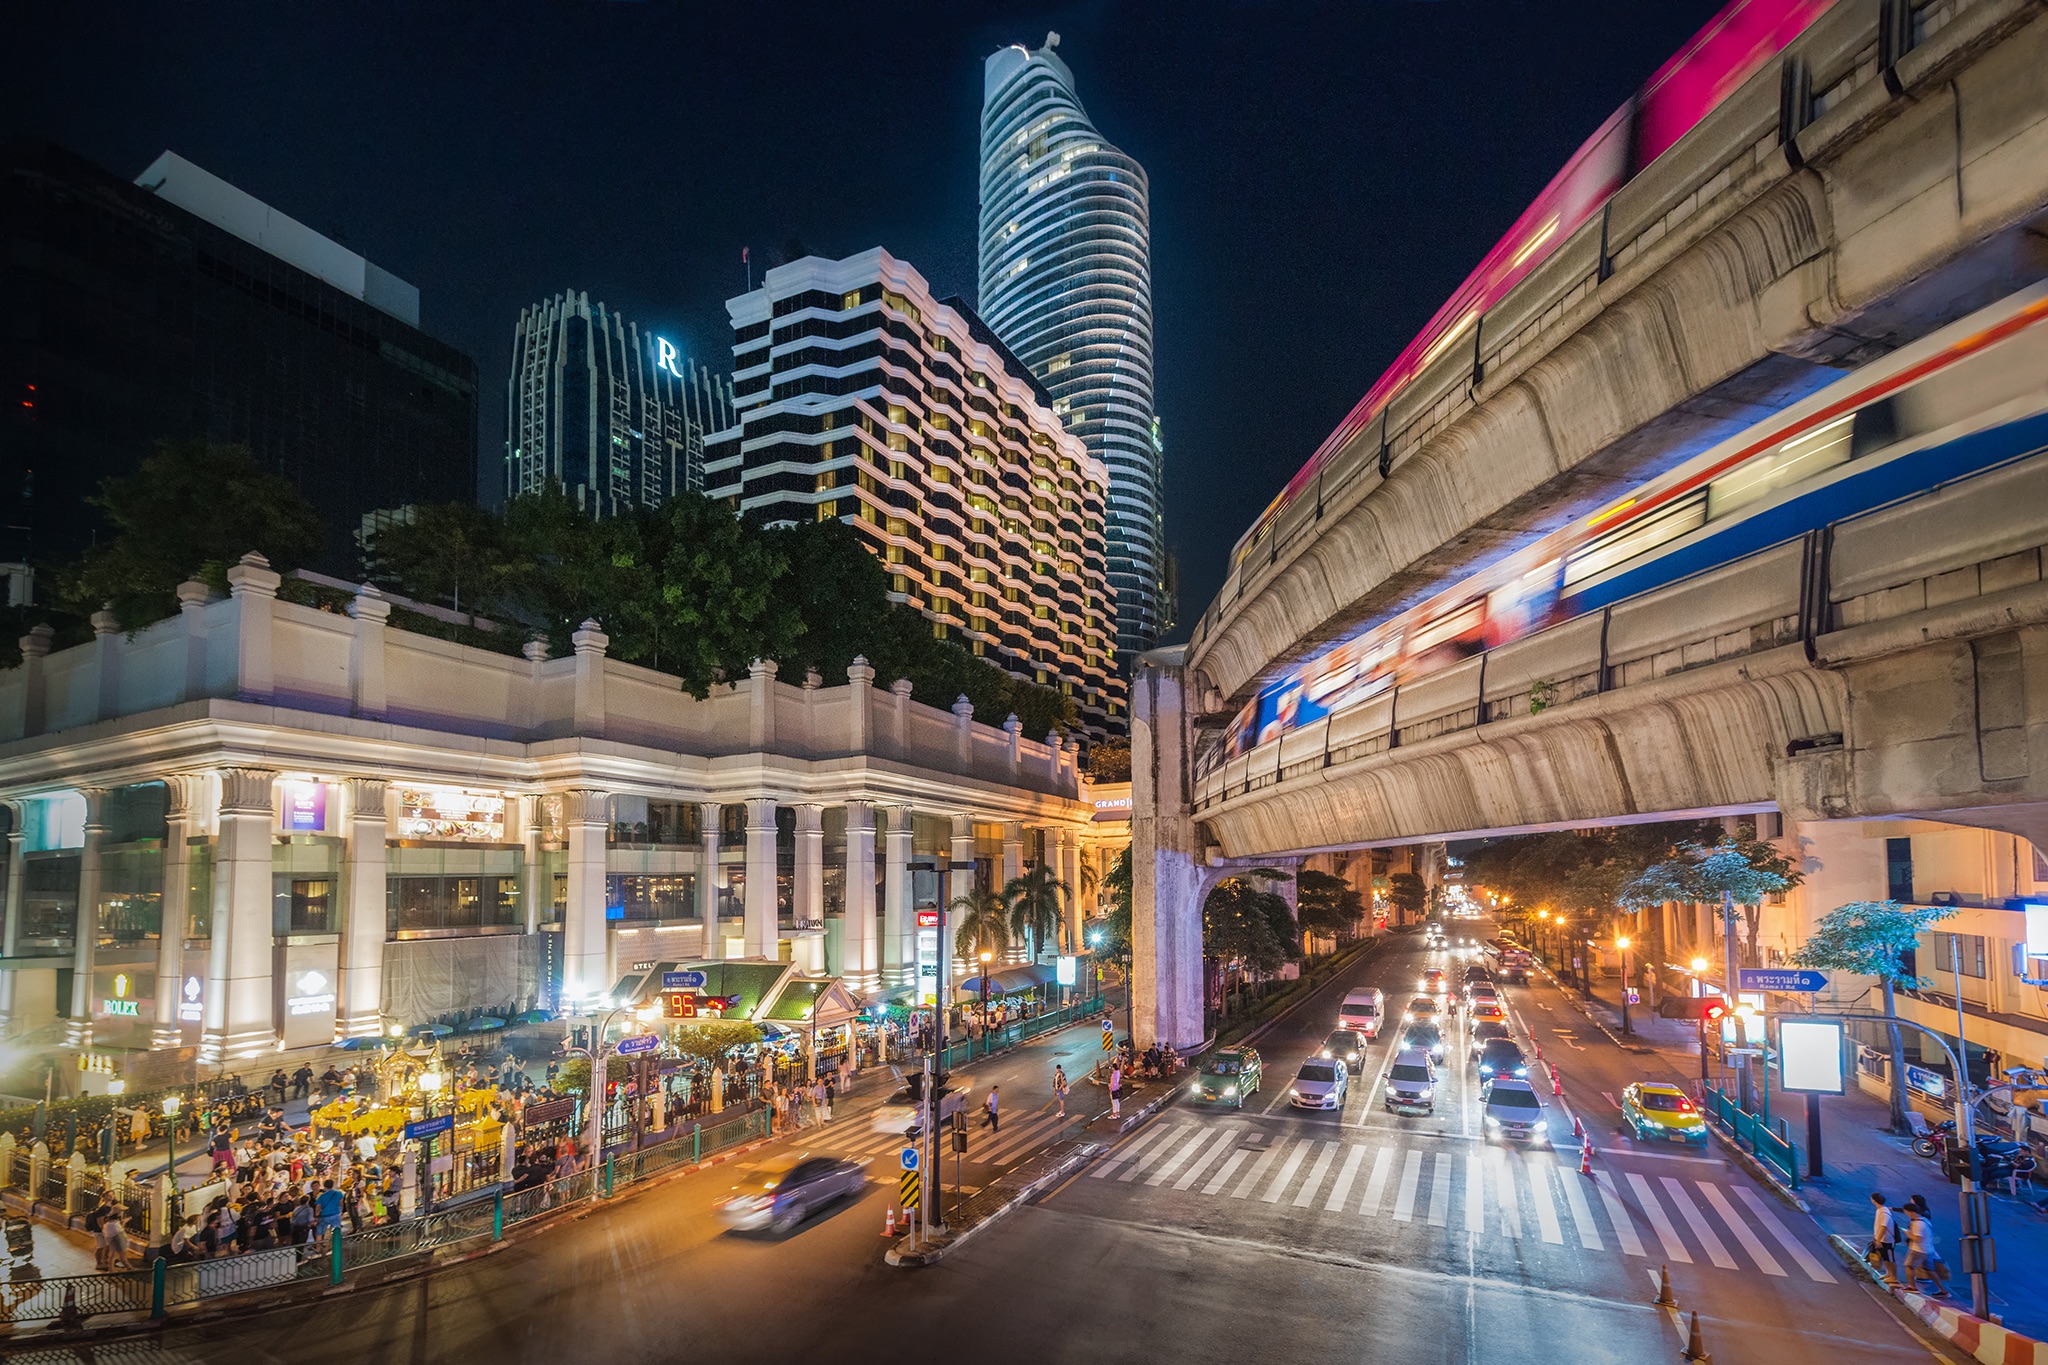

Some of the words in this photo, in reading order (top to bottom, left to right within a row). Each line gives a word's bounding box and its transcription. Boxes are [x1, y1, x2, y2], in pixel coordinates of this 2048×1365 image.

[657, 336, 683, 378] R
[1095, 799, 1126, 808] GRAND
[633, 962, 655, 970] STEL
[103, 1000, 139, 1016] ROLEX
[671, 995, 694, 1016] 95
